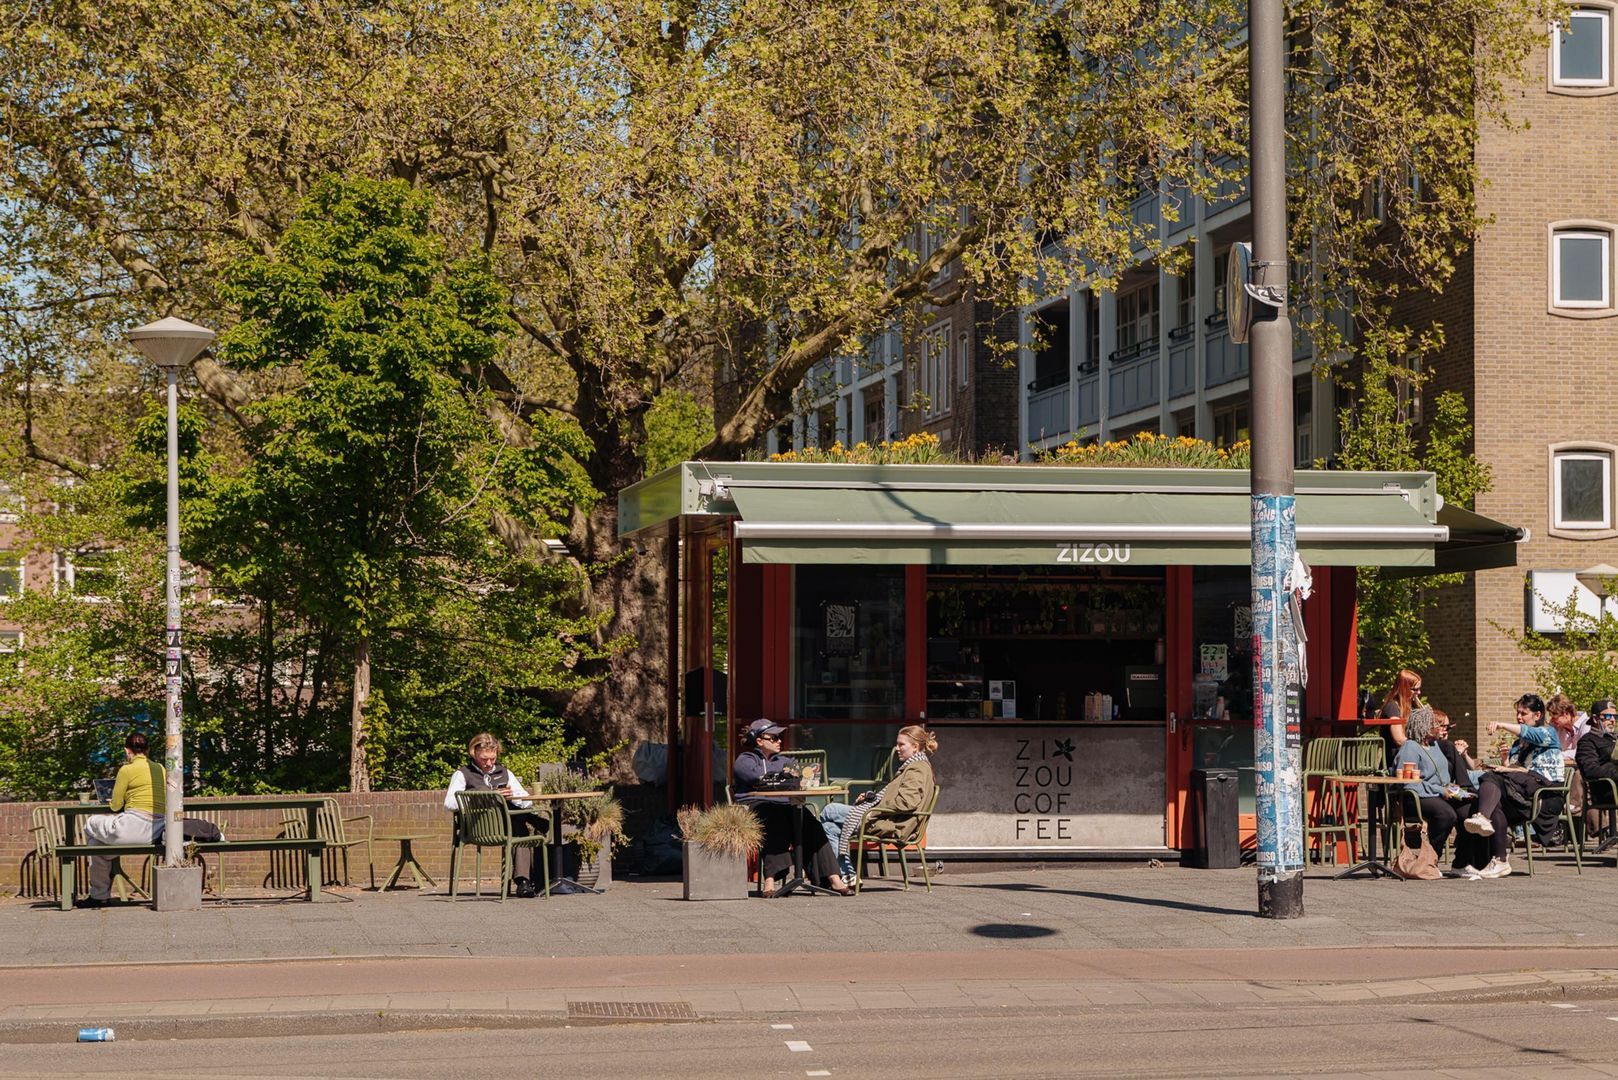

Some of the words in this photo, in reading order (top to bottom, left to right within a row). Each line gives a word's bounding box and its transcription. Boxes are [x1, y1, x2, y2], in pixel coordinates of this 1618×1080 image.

[1056, 543, 1131, 563] ZIZOU
[1016, 766, 1072, 787] ZOU
[1014, 793, 1071, 814] COF
[1016, 819, 1072, 840] FEE
